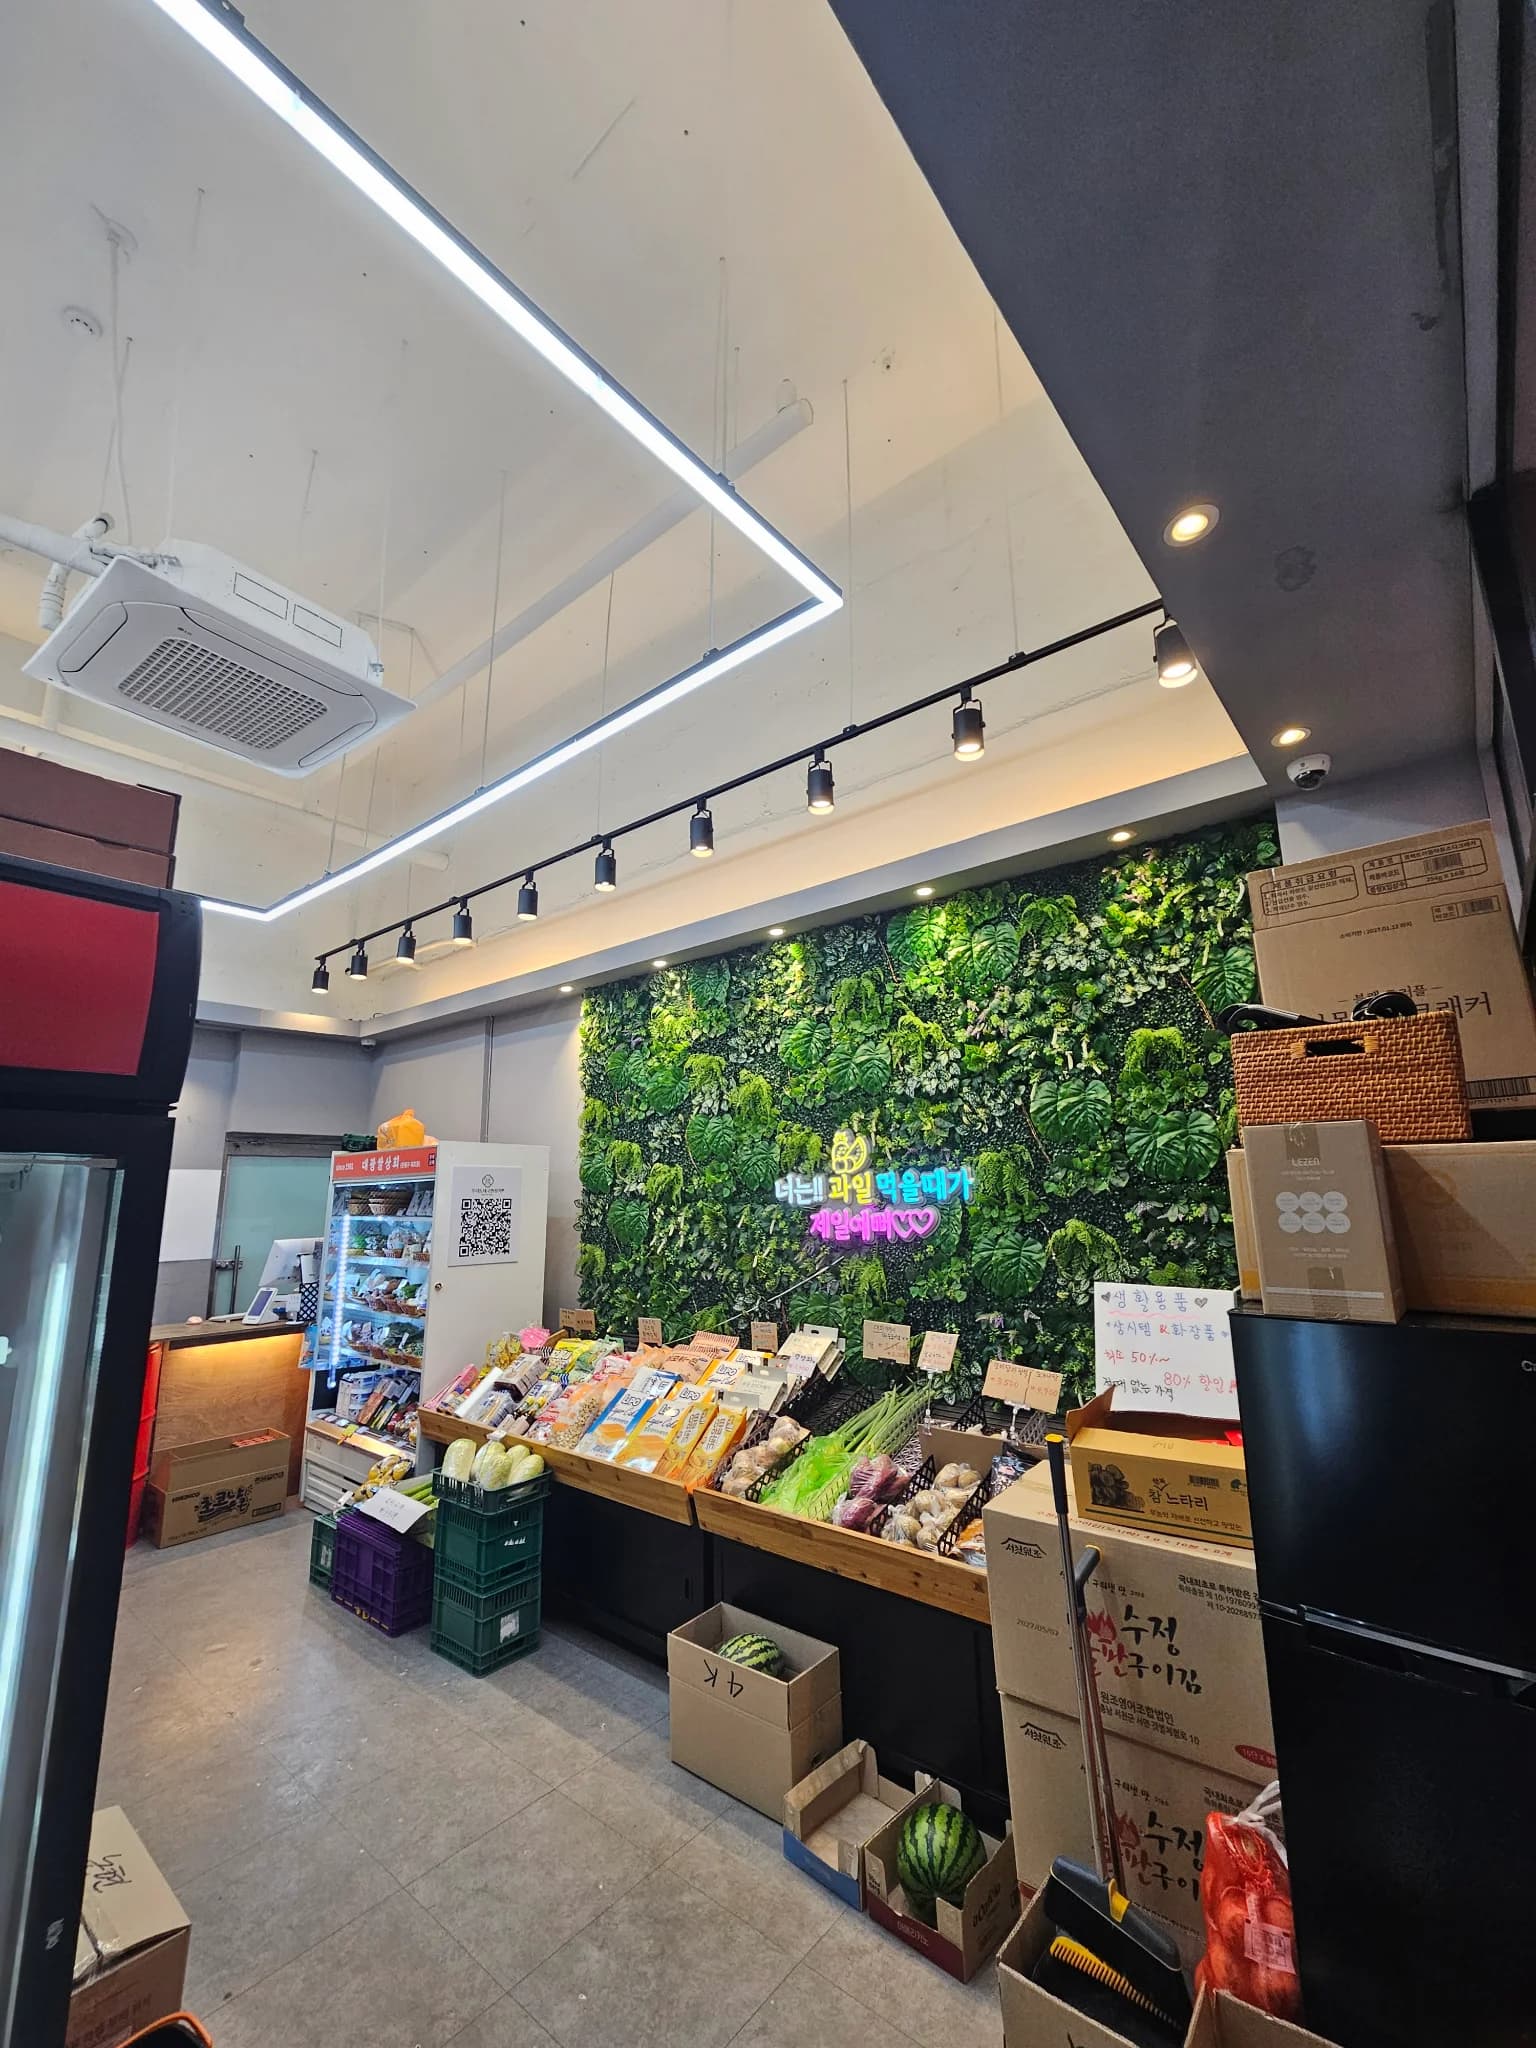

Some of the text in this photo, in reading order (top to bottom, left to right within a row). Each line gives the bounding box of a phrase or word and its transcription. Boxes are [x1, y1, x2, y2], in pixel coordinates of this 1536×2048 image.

[828, 1172, 873, 1205] 과일
[875, 1166, 975, 1205] 먹을때가
[1113, 1288, 1188, 1313] 생활용품
[1170, 1322, 1216, 1342] 화장품
[1163, 1371, 1192, 1389] 80%
[1154, 1384, 1174, 1403] 가격
[1165, 1492, 1209, 1511] 느타리
[1120, 1604, 1181, 1657] 수정
[1143, 1810, 1204, 1873] 수정
